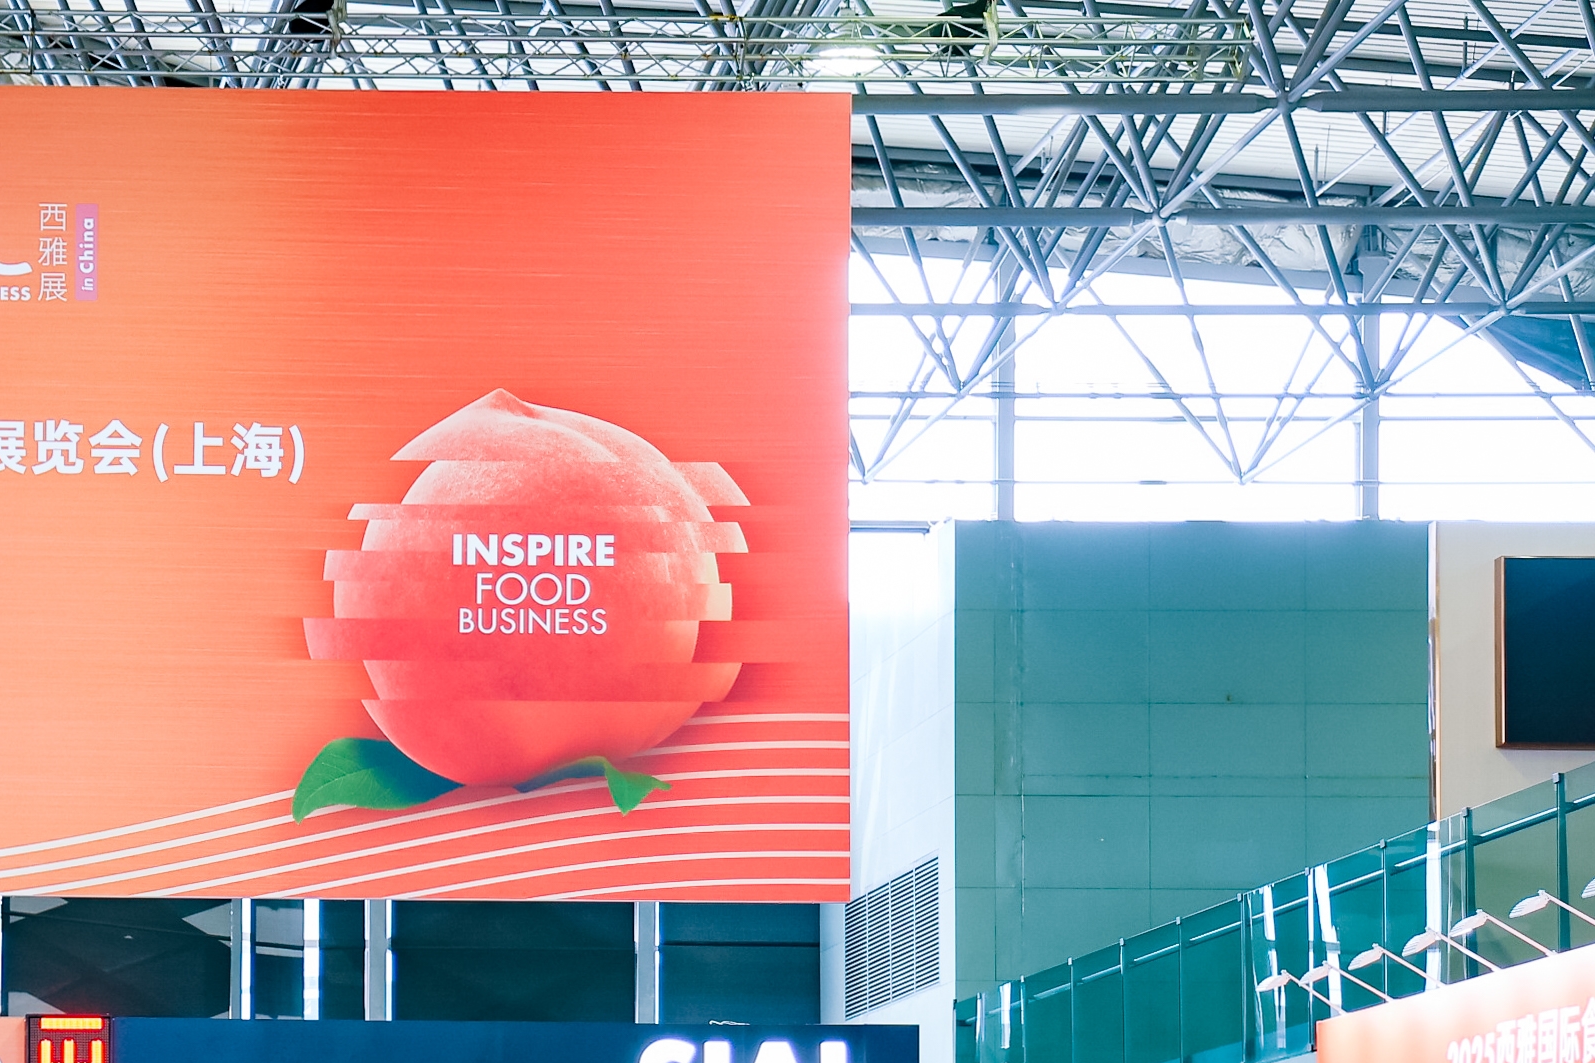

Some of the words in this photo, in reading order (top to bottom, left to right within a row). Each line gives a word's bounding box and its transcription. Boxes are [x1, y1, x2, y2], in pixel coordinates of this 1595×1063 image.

[37, 202, 68, 302] 西雅展
[79, 217, 96, 273] China
[79, 276, 96, 292] in
[452, 534, 615, 567] INSPIRE
[476, 573, 591, 605] FOOD
[459, 607, 608, 635] BUSINESS
